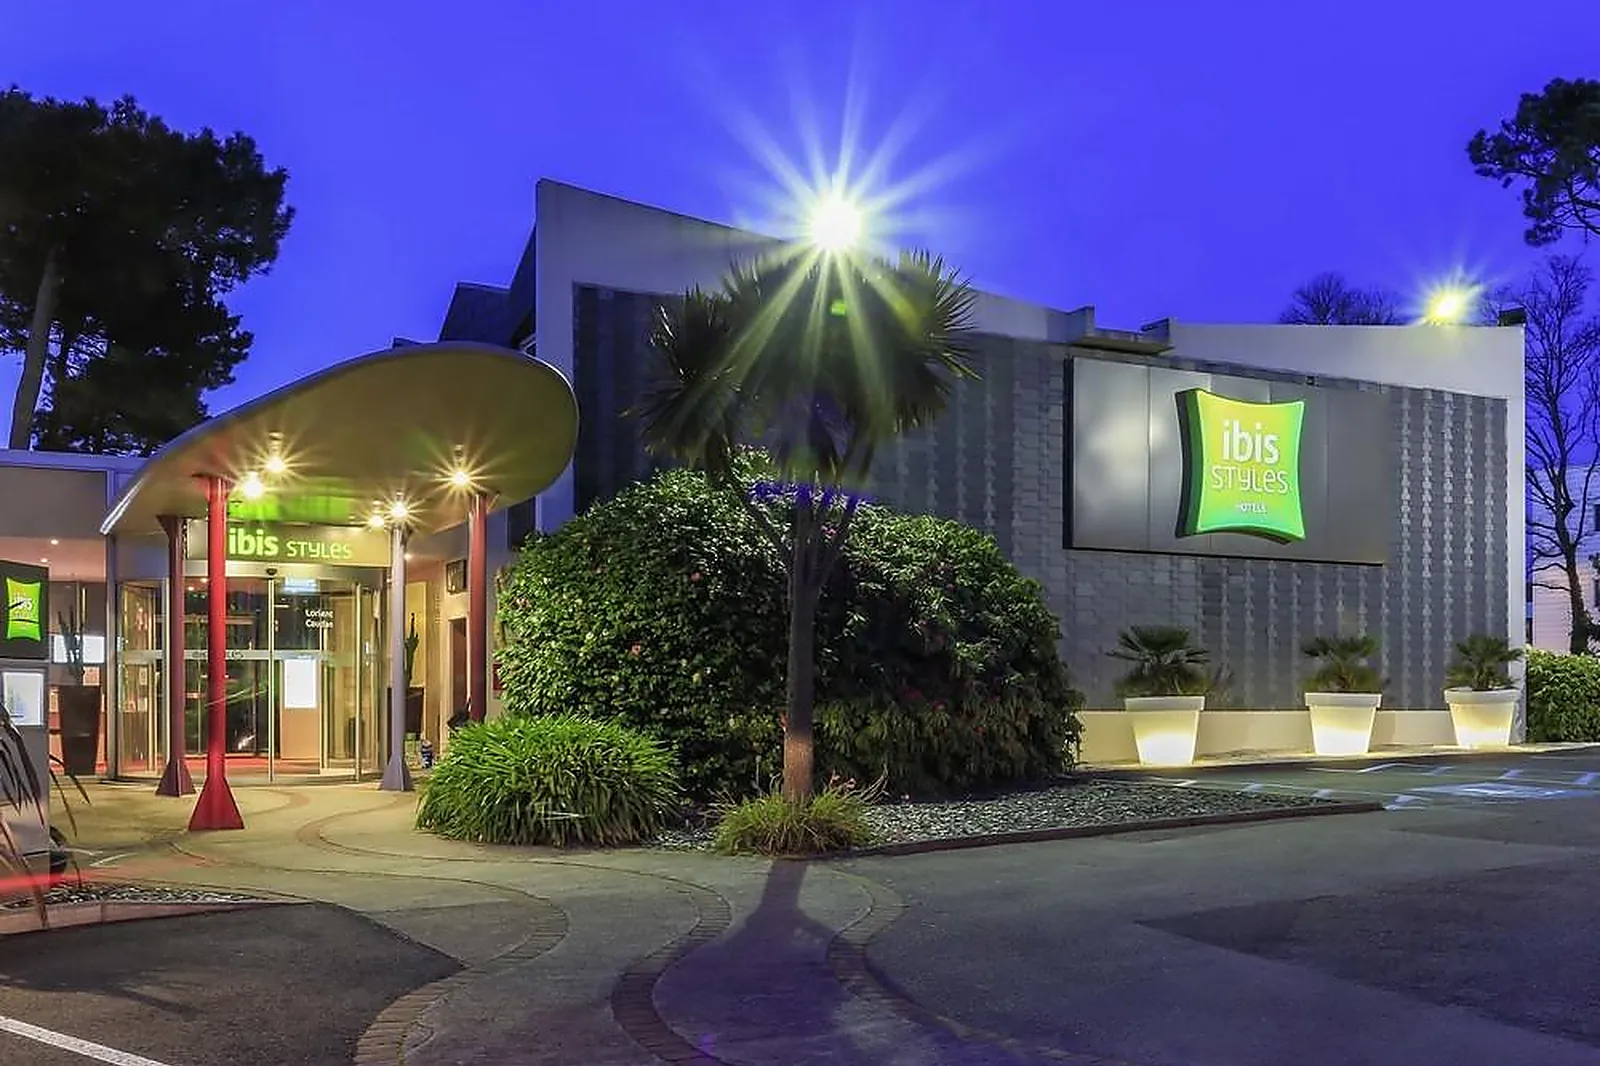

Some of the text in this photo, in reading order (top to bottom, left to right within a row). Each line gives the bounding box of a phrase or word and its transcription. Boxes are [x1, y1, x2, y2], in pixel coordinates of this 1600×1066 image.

[1223, 419, 1280, 464] ibis
[1211, 465, 1289, 494] STYLES
[228, 527, 353, 560] ibis STYLES
